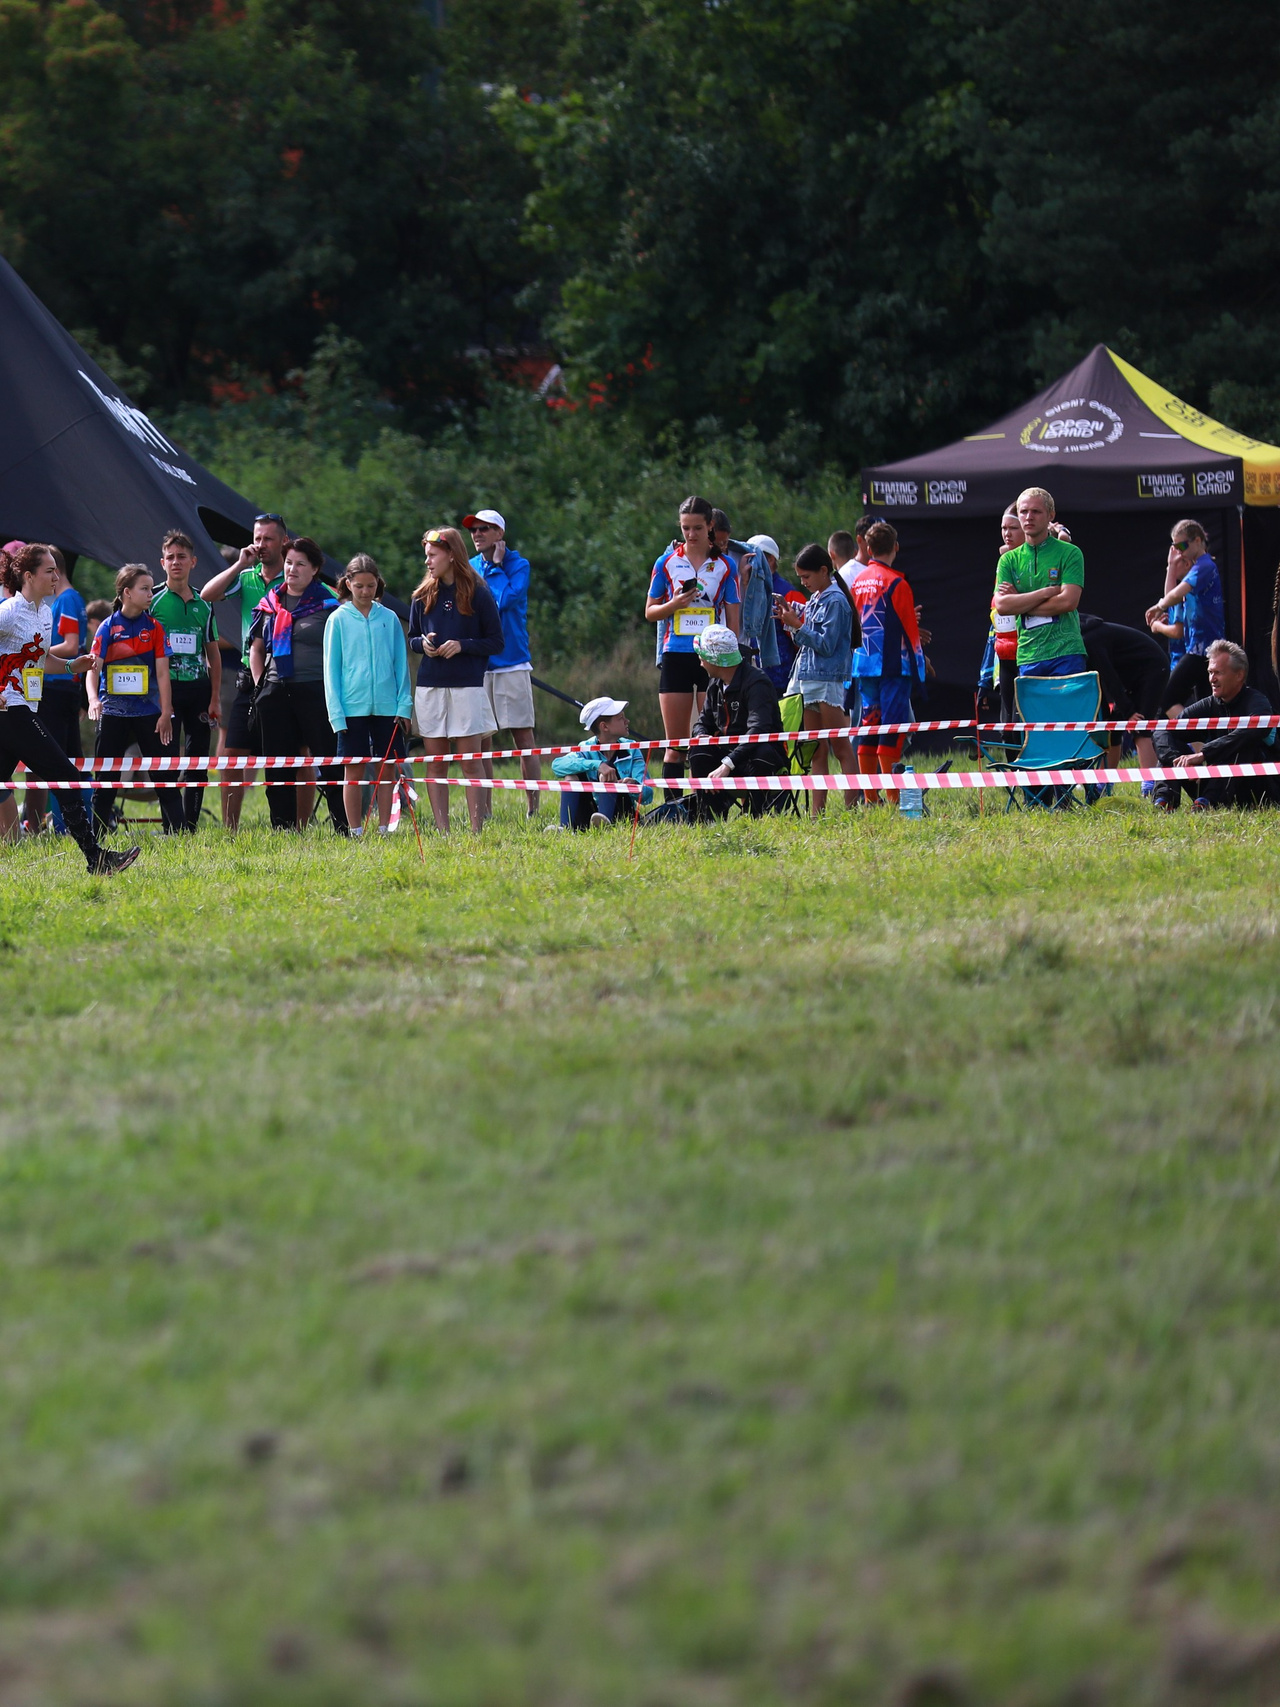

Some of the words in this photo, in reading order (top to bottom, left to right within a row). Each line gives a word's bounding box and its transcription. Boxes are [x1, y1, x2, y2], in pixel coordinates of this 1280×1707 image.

[1141, 474, 1186, 487] TIMING
[1196, 470, 1235, 484] OPEN
[1153, 485, 1186, 498] BAND
[1197, 482, 1231, 496] BAND
[685, 619, 704, 627] 200.2
